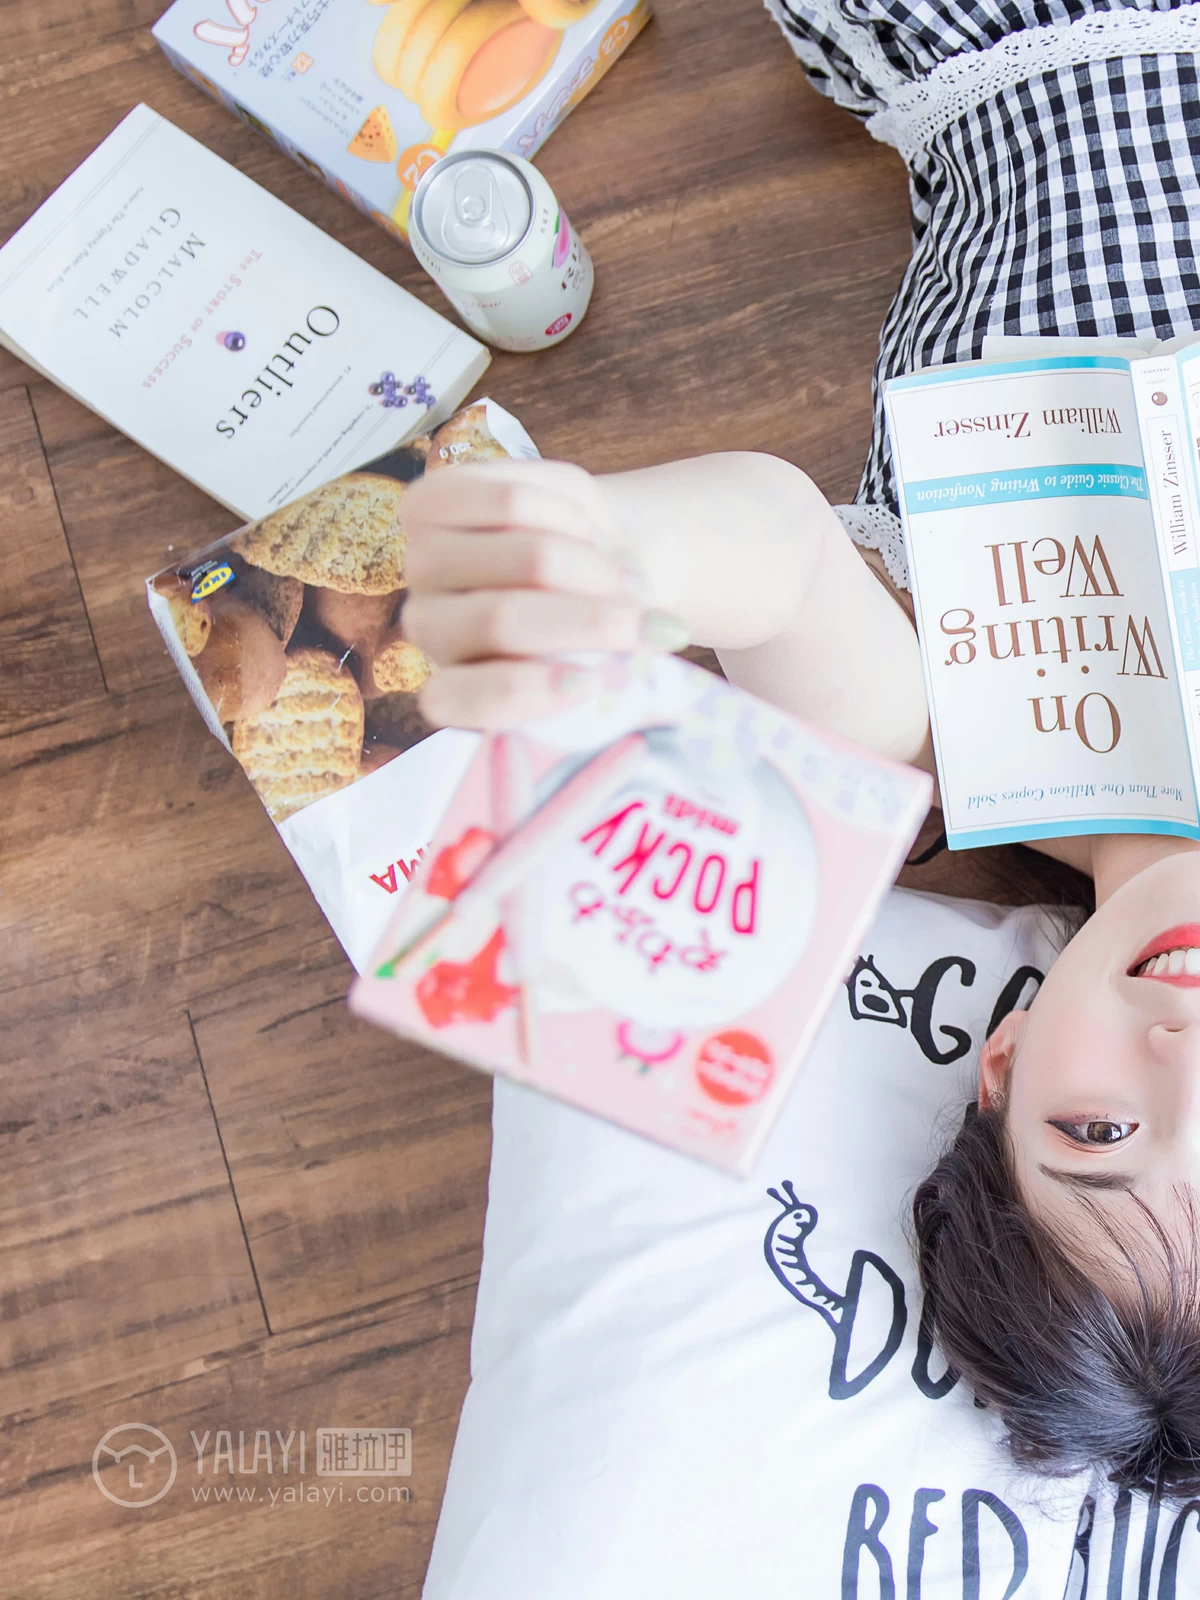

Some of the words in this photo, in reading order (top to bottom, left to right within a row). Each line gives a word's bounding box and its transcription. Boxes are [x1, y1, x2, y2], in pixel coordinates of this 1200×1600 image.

[598, 16, 632, 56] C2
[216, 306, 339, 438] Outliers
[932, 411, 1031, 445] Zinsser
[1041, 402, 1122, 440] William
[1155, 428, 1180, 488] Zinsser
[988, 474, 1040, 496] Writing
[1043, 475, 1057, 487] to
[1059, 471, 1095, 490] Guide
[1096, 470, 1130, 492] Classic
[1129, 474, 1144, 492] The
[915, 481, 987, 504] Nonfiction
[1165, 493, 1189, 555] William
[985, 533, 1124, 607] Well
[940, 606, 1169, 680] Writing
[1028, 691, 1123, 755] On
[1000, 783, 1044, 805] Copies
[1048, 780, 1096, 799] Million
[1100, 782, 1124, 796] One
[1127, 783, 1157, 798] Than
[1159, 785, 1183, 802] More
[966, 791, 997, 811] Sold
[370, 841, 434, 896] MA
